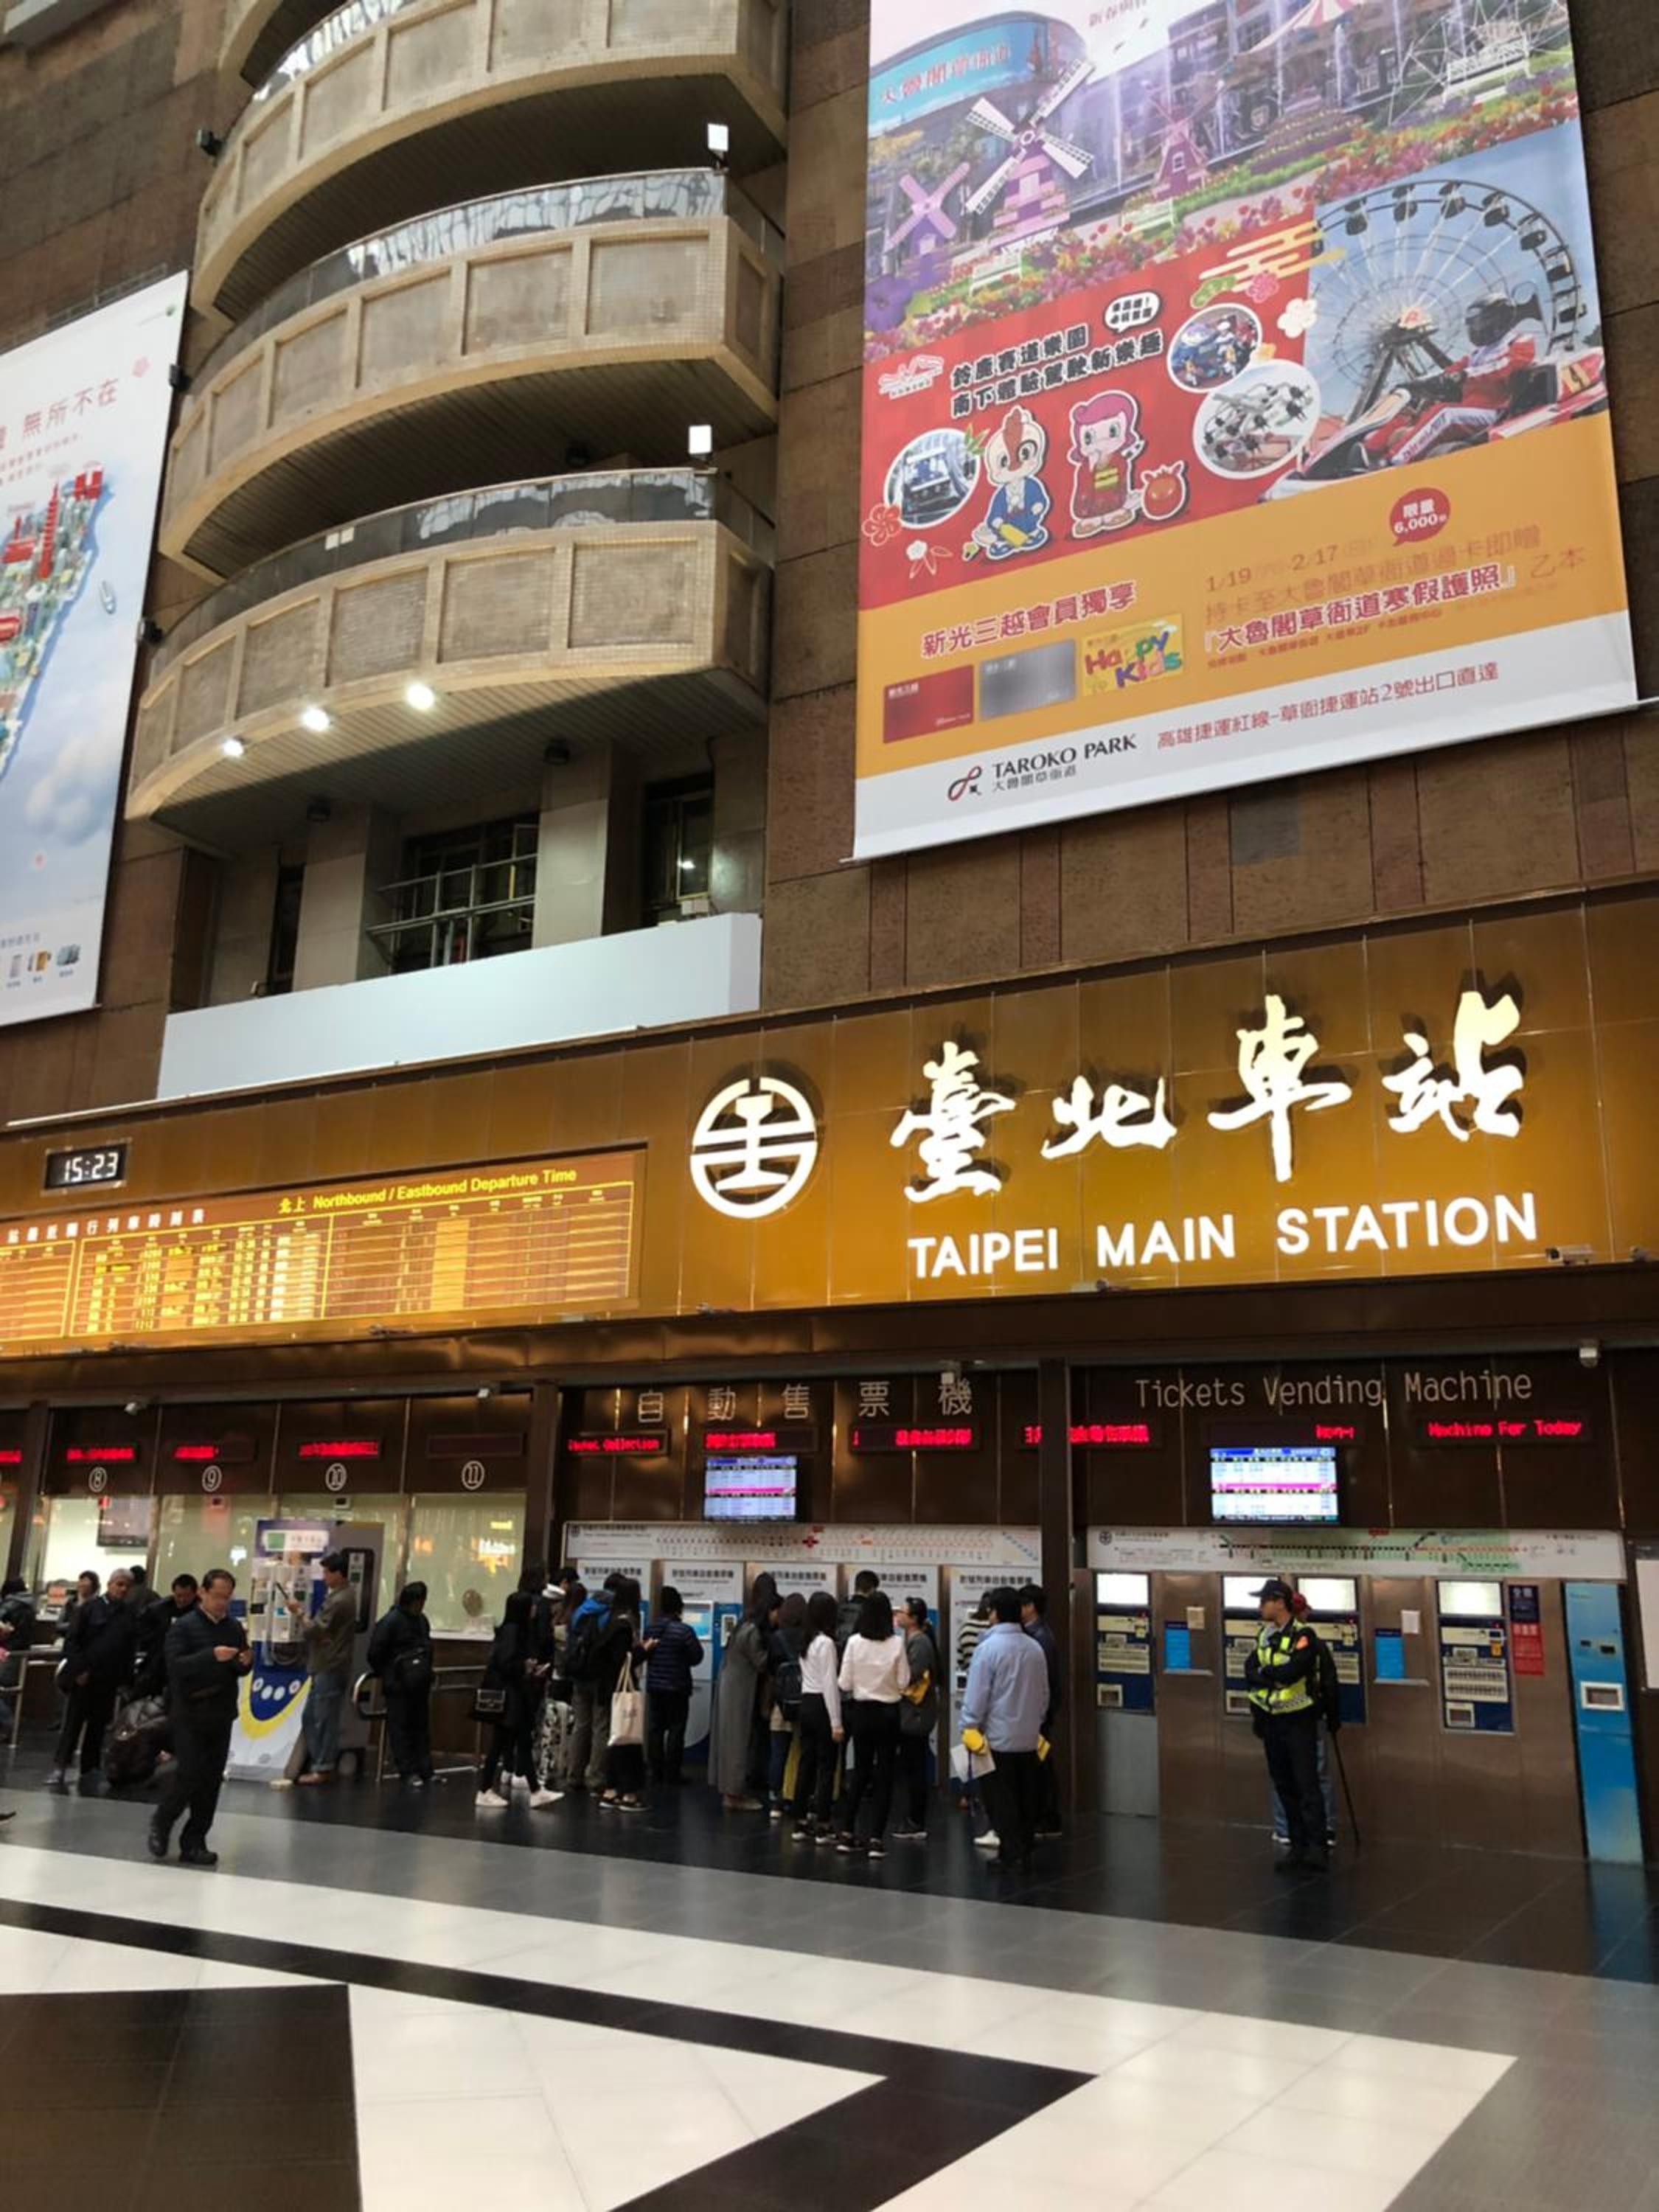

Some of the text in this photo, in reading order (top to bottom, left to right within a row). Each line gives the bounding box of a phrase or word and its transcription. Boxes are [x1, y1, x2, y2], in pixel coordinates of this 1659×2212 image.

[922, 581, 1135, 657] 新光三越會員獨享
[992, 734, 1138, 778] TAROKO PARK
[891, 992, 1524, 1203] 臺北車站
[64, 1151, 119, 1183] 15:23
[278, 1196, 306, 1214] 北上
[313, 1186, 386, 1209] Northbound
[397, 1178, 467, 1201] Eastbound
[471, 1174, 538, 1195] Departure
[543, 1168, 577, 1185] Time
[908, 1193, 1537, 1277] TAIPEI MAIN STATION
[637, 1377, 973, 1424] 自動售票機
[1135, 1369, 1533, 1408] Tickets Vending Machine
[1534, 1419, 1582, 1436] Today
